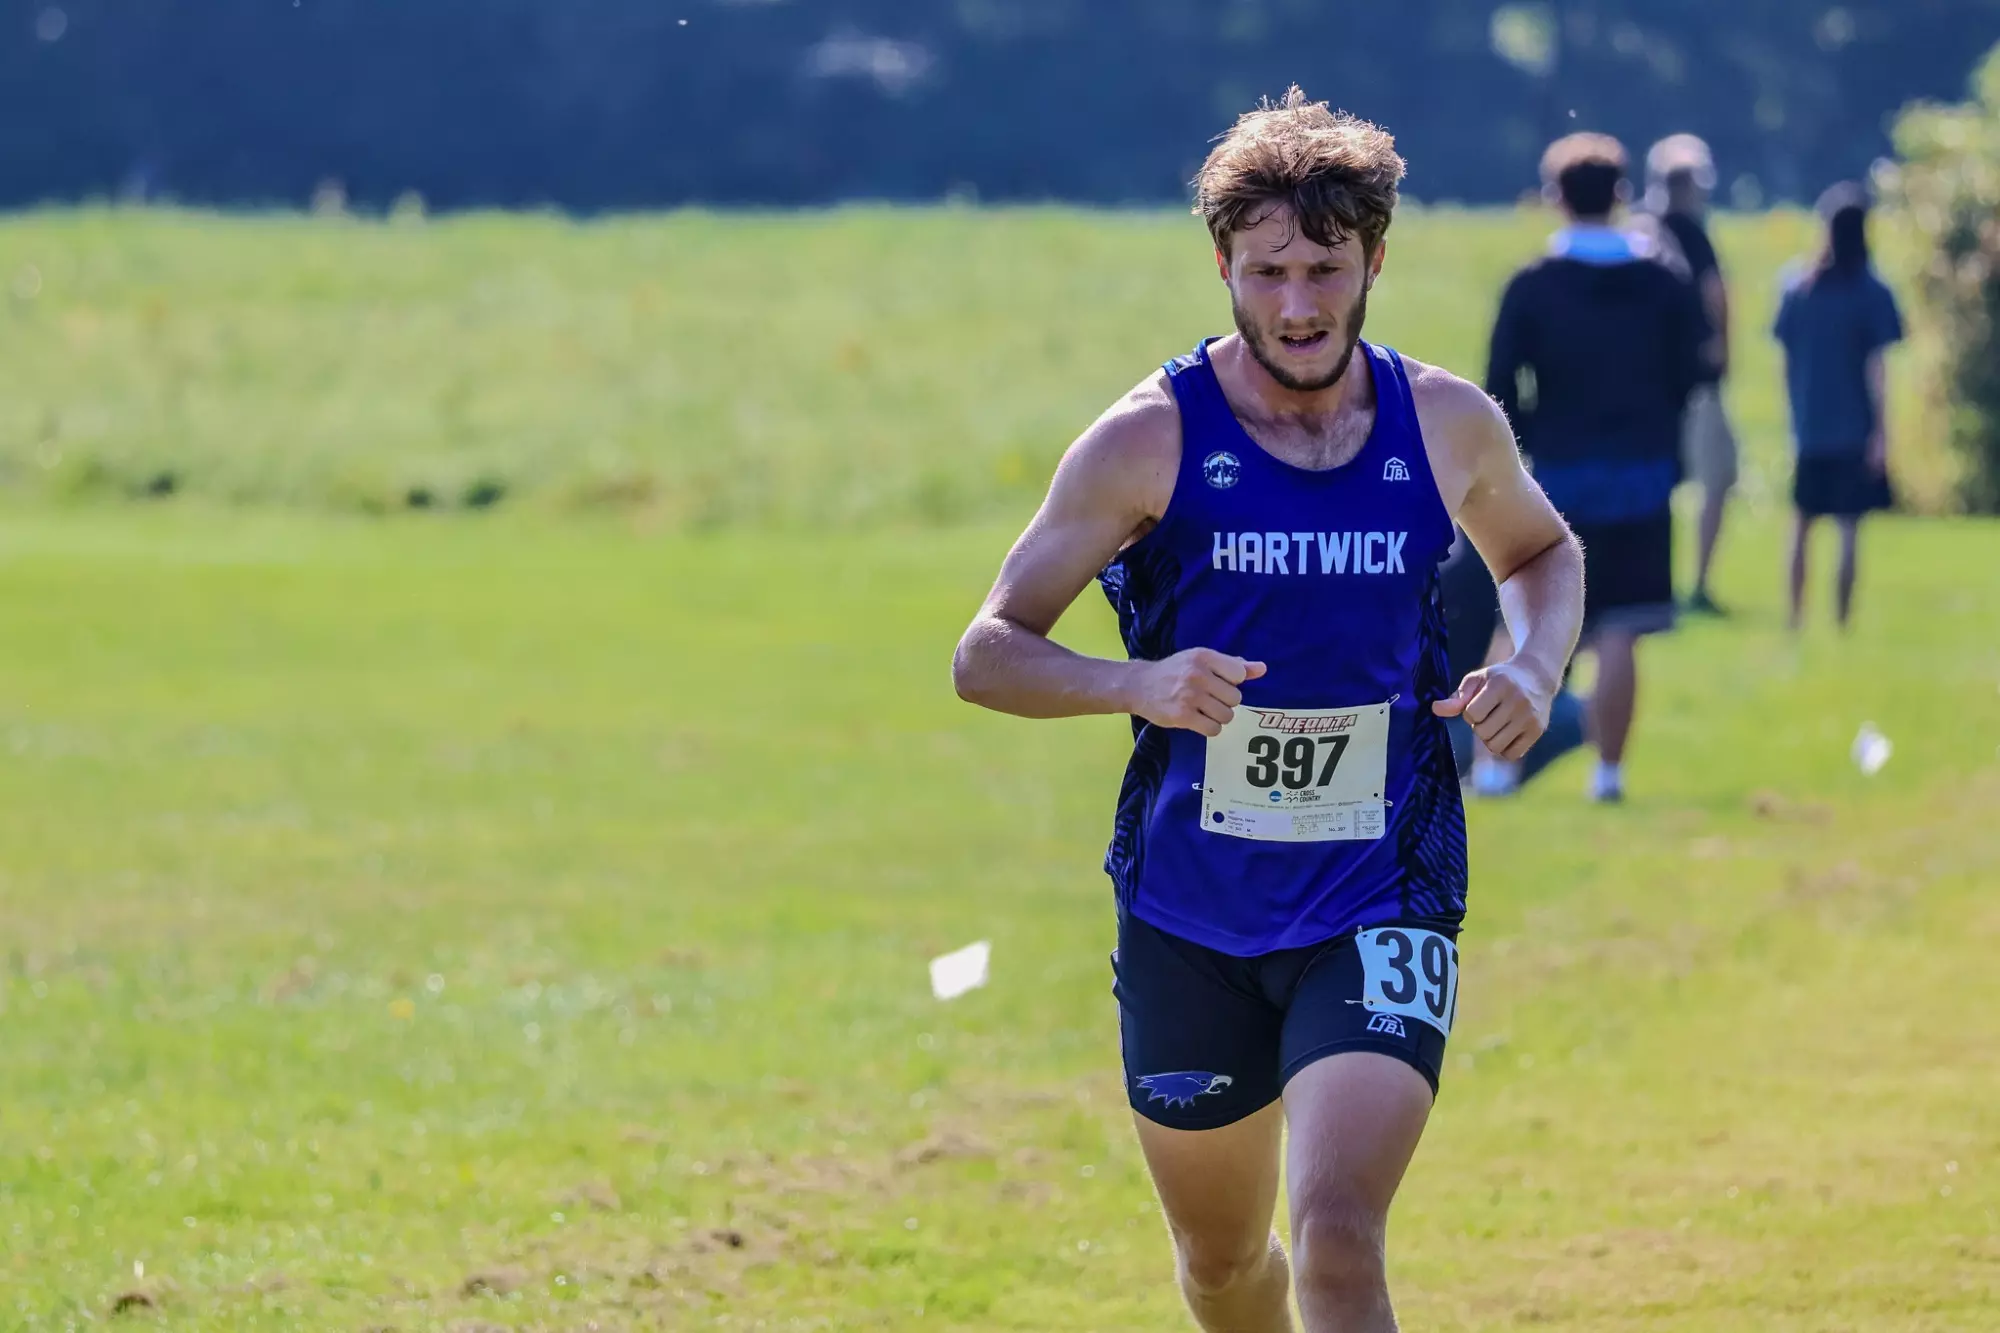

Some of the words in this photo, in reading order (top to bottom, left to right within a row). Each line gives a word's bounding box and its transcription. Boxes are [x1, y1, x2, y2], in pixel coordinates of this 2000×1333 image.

[1212, 531, 1408, 575] HARTWICK
[1256, 711, 1358, 729] ONEONTA
[1245, 734, 1350, 790] 397
[1300, 789, 1315, 797] CROSS
[1300, 795, 1321, 803] COUNTRY
[1376, 929, 1459, 1033] 39
